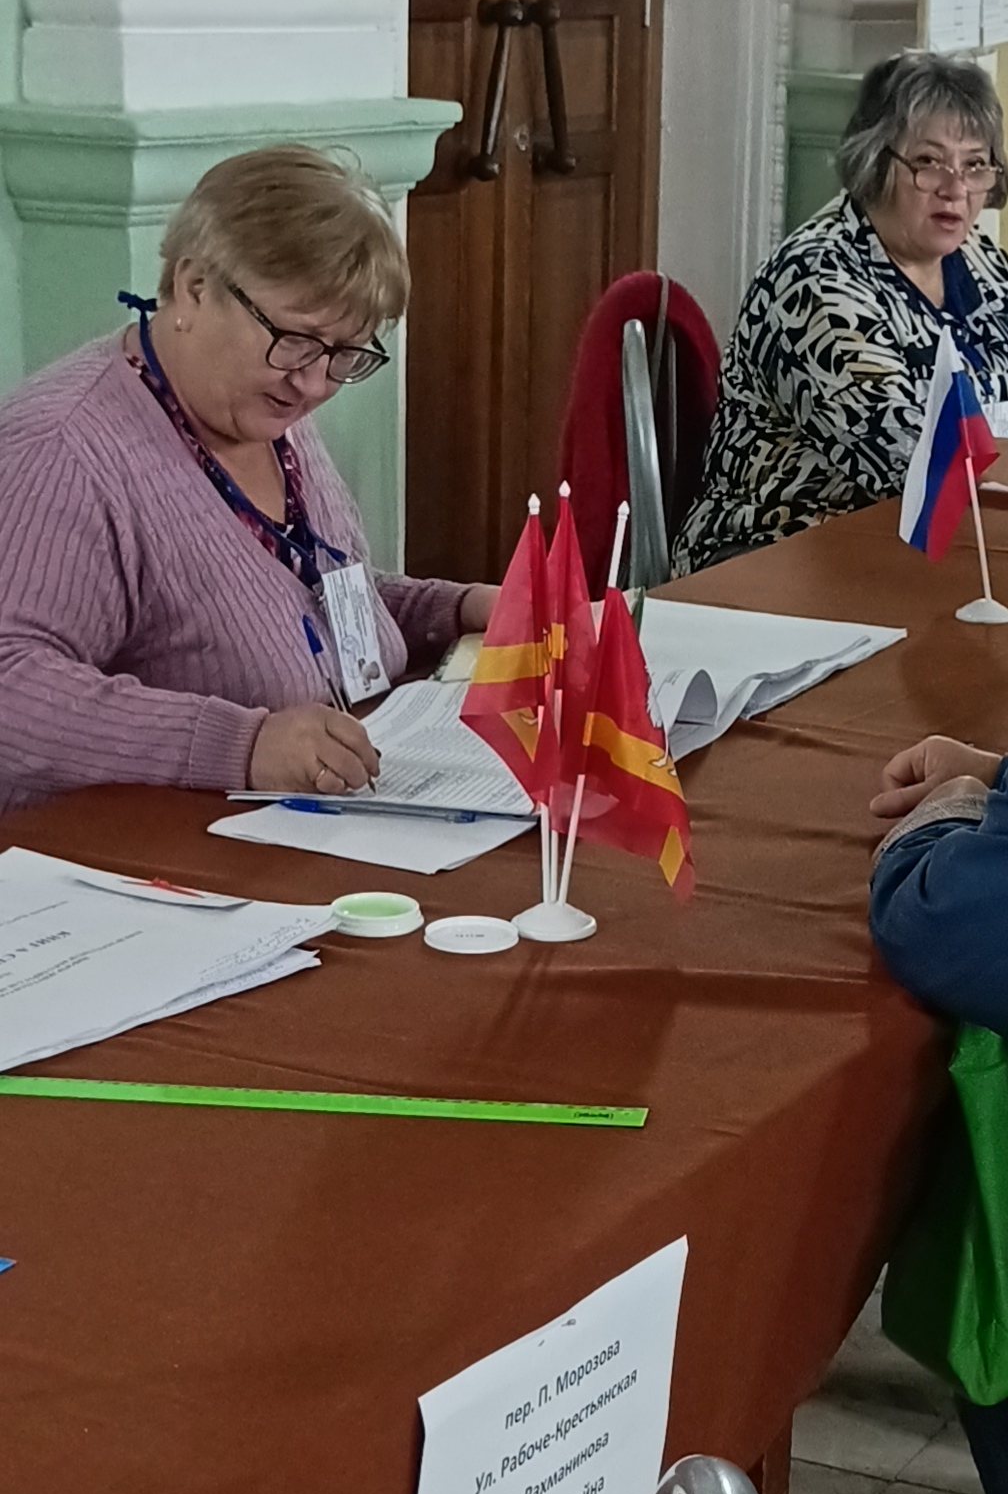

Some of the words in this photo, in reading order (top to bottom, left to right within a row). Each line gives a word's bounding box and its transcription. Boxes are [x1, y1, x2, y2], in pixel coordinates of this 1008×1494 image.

[501, 1369, 638, 1478] Рабоче-Крестьянская
[505, 1401, 535, 1430] пер.
[538, 1384, 552, 1407] П.
[556, 1340, 621, 1396] Морозова
